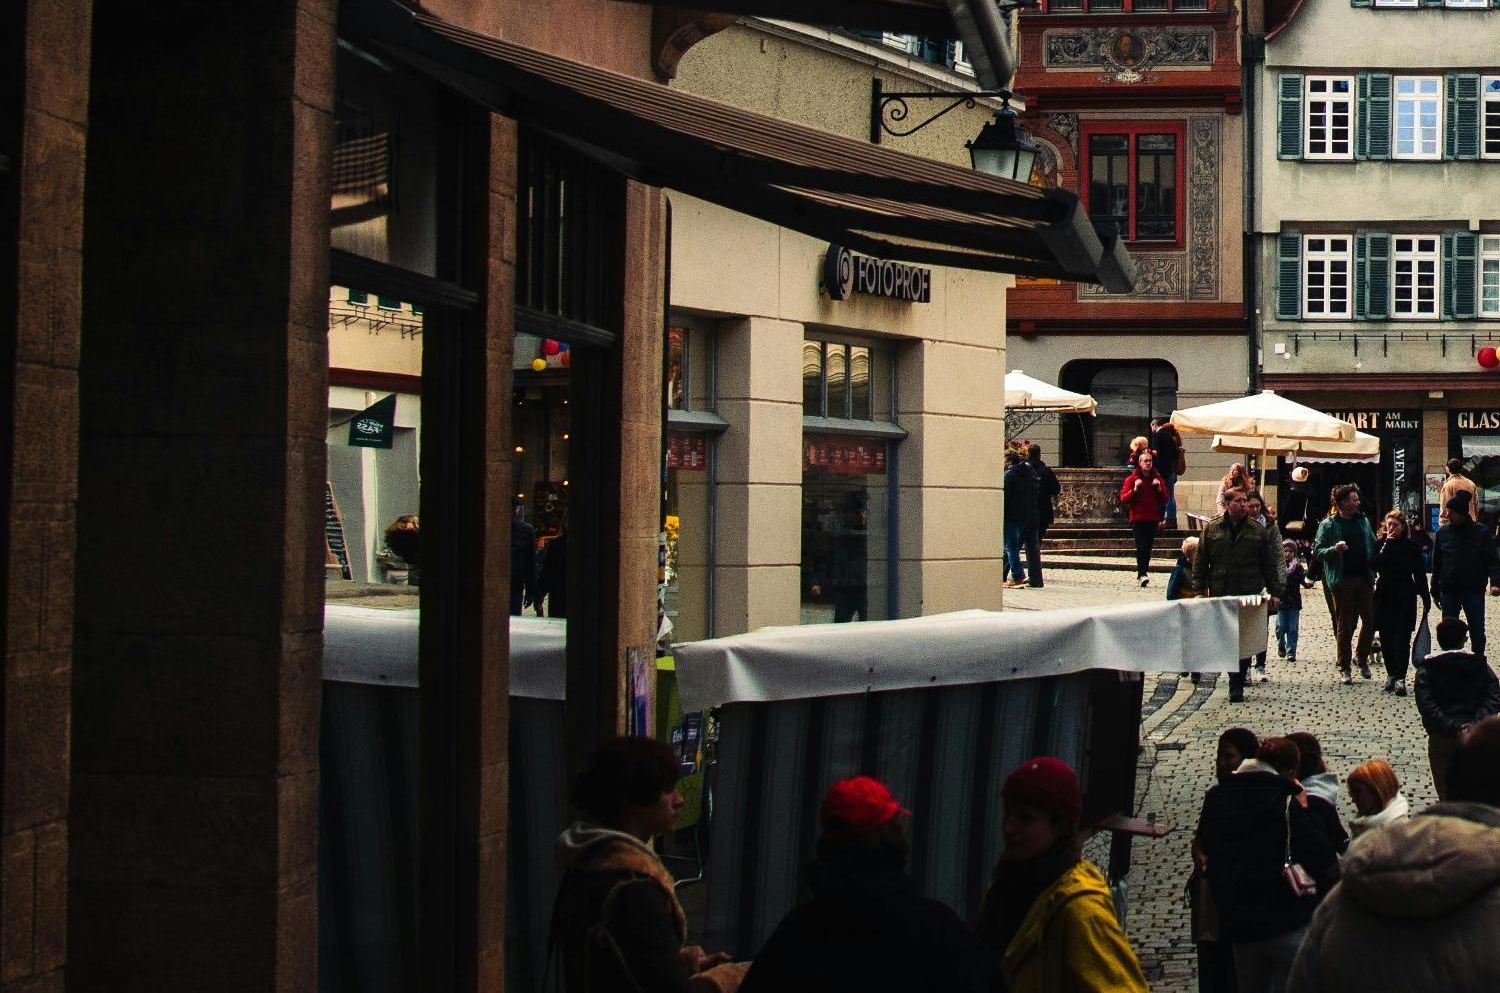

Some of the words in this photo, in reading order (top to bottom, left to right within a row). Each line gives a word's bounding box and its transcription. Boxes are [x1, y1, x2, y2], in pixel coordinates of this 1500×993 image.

[858, 256, 929, 302] FOTOPROF
[1385, 412, 1401, 420] AM
[1385, 420, 1419, 429] MARKT
[1395, 448, 1405, 482] WEIN
